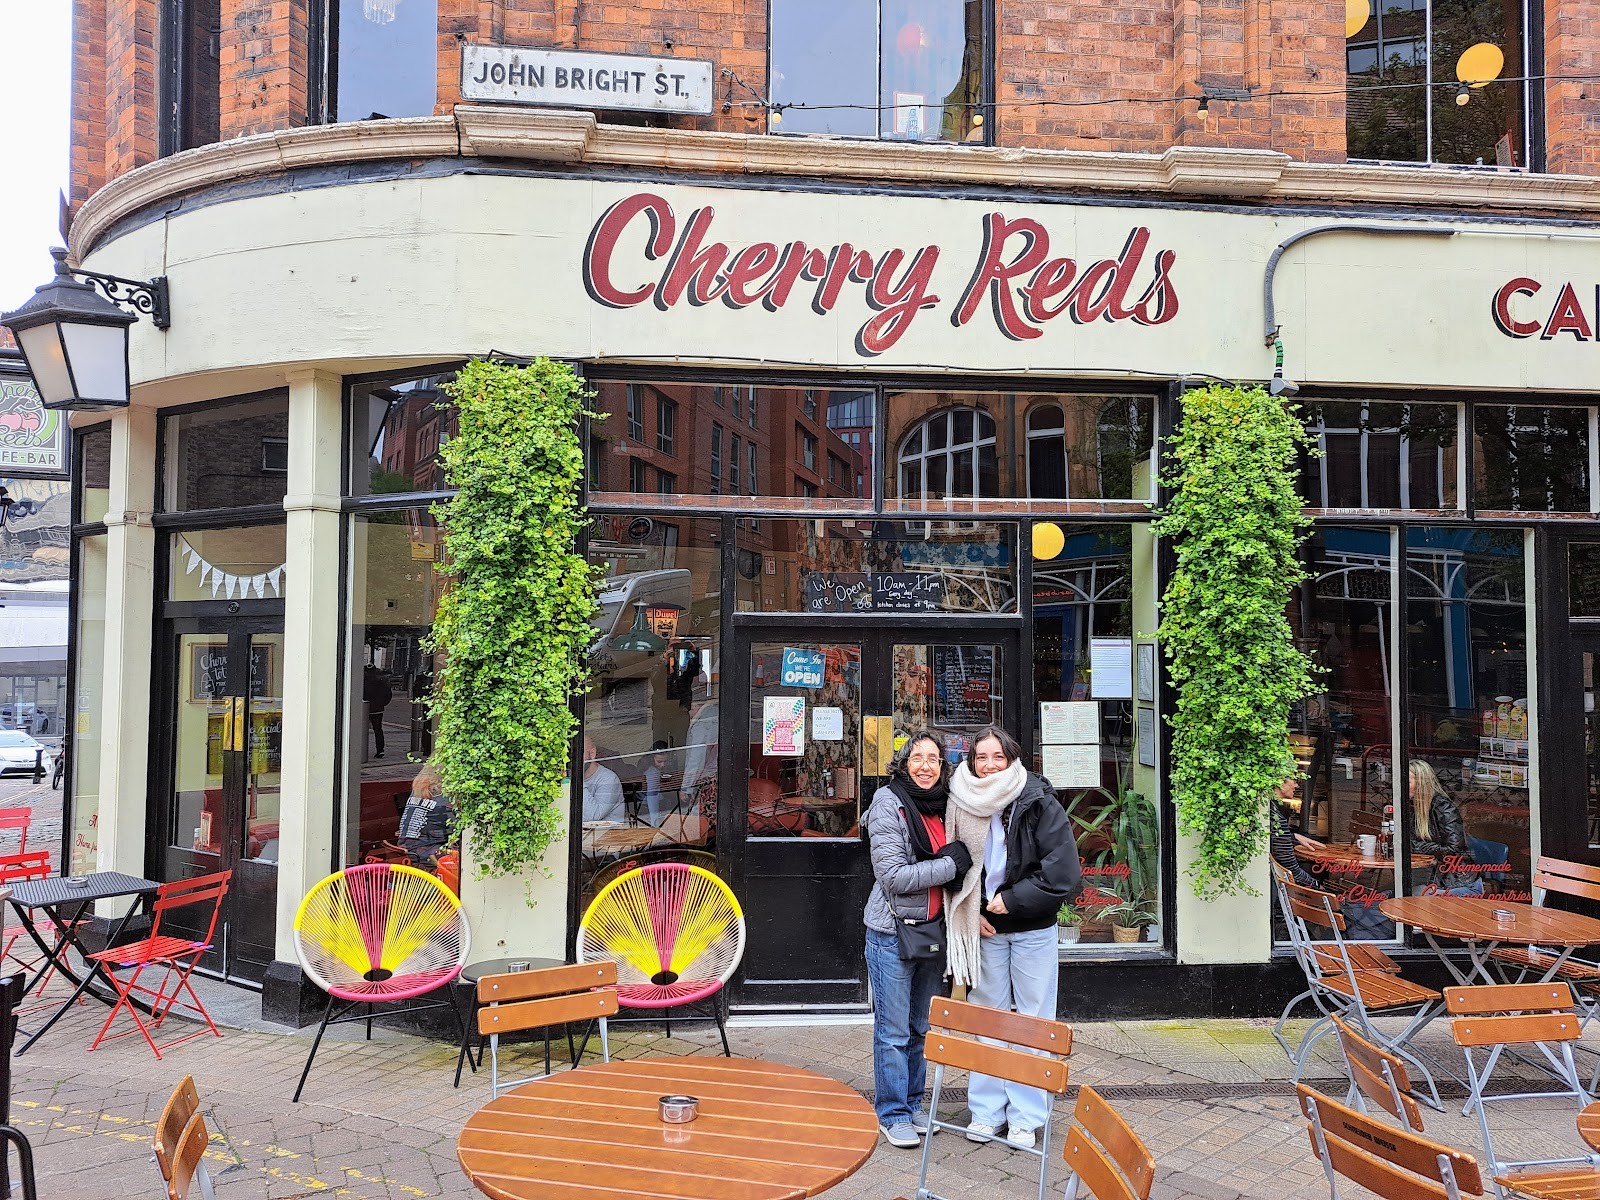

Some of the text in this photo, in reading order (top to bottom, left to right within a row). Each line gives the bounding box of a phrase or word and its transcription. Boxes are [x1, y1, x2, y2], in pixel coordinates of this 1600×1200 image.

[473, 62, 545, 87] JOHN
[555, 66, 646, 94] BRIGHT
[582, 192, 1181, 358] Cherry Reds
[1491, 277, 1600, 342] CA
[2, 451, 56, 465] FE-BAR
[812, 577, 834, 592] We
[835, 580, 866, 602] Open
[812, 595, 832, 609] are
[655, 608, 678, 618] Duvel
[787, 651, 822, 665] Come In
[784, 670, 821, 684] OPEN
[1312, 856, 1365, 877] Freshly
[1439, 855, 1512, 873] Homemade
[1348, 884, 1388, 908] Coffee
